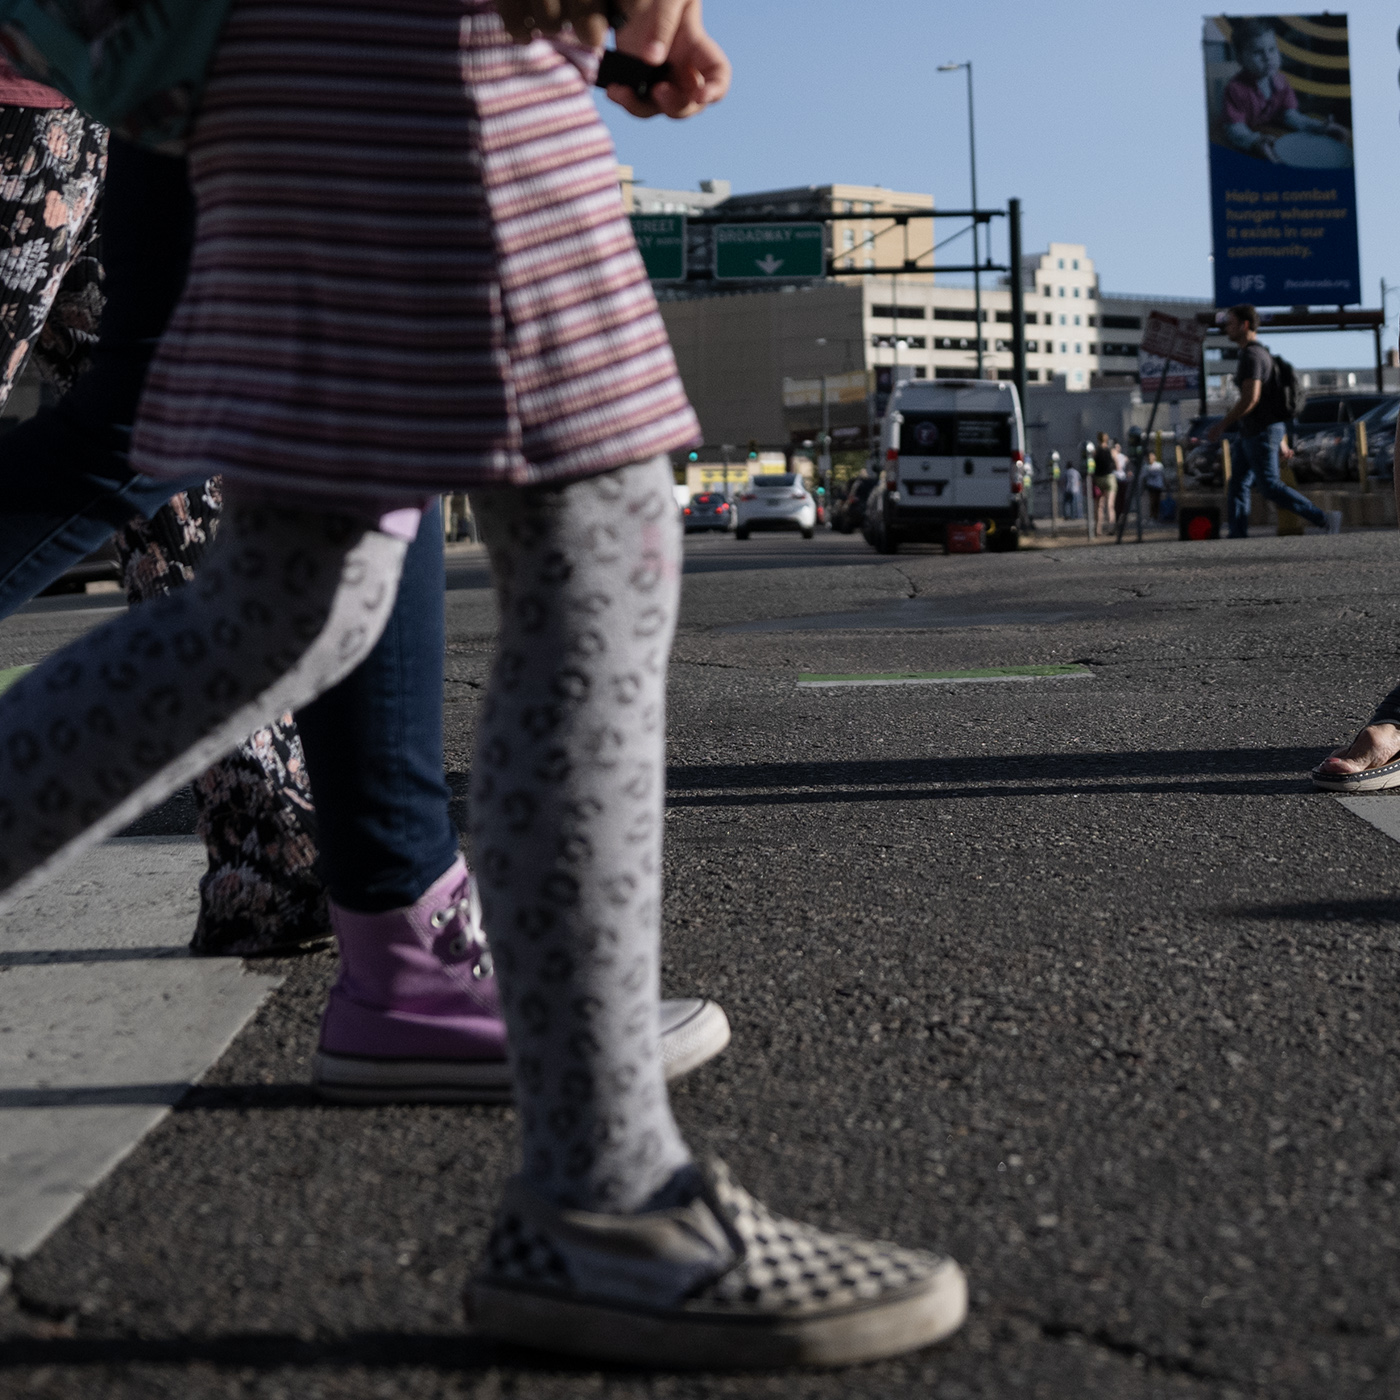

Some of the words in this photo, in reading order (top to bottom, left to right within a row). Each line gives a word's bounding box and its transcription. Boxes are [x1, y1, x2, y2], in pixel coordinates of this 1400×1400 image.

[1225, 188, 1260, 204] Help
[1262, 191, 1279, 202] us
[1282, 188, 1338, 202] combat
[1226, 208, 1278, 223] hunger
[1280, 207, 1348, 220] wherever
[719, 227, 793, 243] BROADWAY
[1240, 226, 1282, 239] exists
[1300, 227, 1325, 239] our
